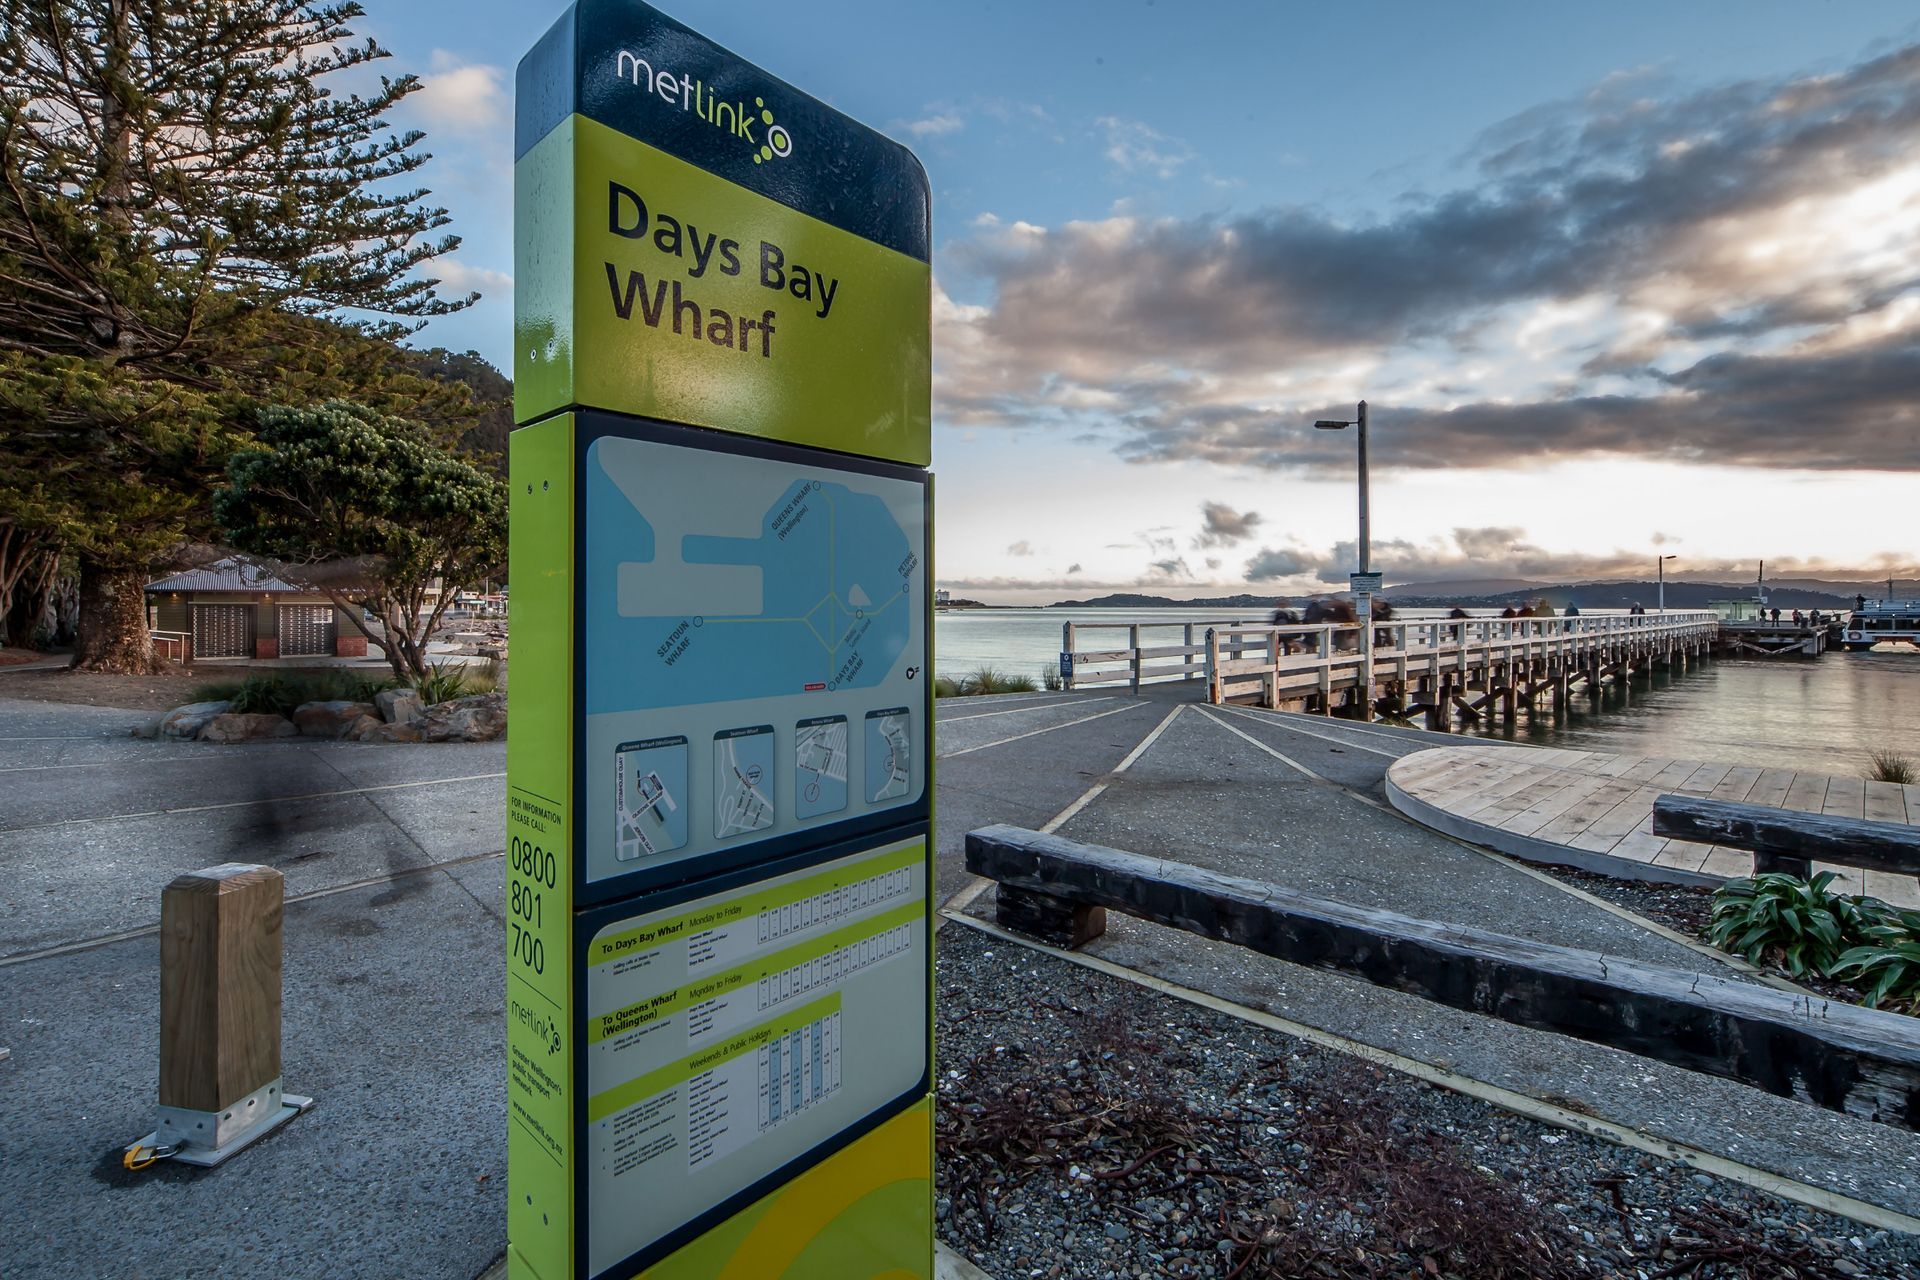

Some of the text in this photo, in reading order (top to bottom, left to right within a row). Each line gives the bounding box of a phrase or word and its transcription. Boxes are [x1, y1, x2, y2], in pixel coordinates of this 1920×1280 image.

[617, 50, 756, 144] metlink
[608, 180, 839, 319] Days Bay
[604, 261, 776, 358] Wharf
[771, 482, 811, 530] QUEENS WHARF
[657, 620, 690, 657] SEATOUN
[665, 636, 690, 666] WHARF
[835, 650, 858, 684] DAYS BAY
[846, 658, 863, 683] WHARF
[511, 797, 561, 825] FOR INFORMATION
[511, 810, 530, 826] PLEASE
[512, 836, 556, 889] 0800
[512, 880, 541, 928] 801
[689, 914, 715, 927] Monday
[725, 905, 742, 916] Friday
[512, 922, 544, 975] 700
[602, 944, 613, 954] To
[615, 938, 637, 950] Days
[639, 932, 655, 944] Bay
[658, 921, 684, 937] Wharf
[689, 982, 715, 998] Monday
[725, 974, 742, 986] Friday
[512, 1000, 549, 1043] metlink
[602, 991, 677, 1025] To Queens Wharf
[602, 1009, 658, 1038] (Wellington)
[689, 1049, 721, 1070] Weekends
[730, 1039, 746, 1052] Public
[748, 1029, 771, 1044] Holidays
